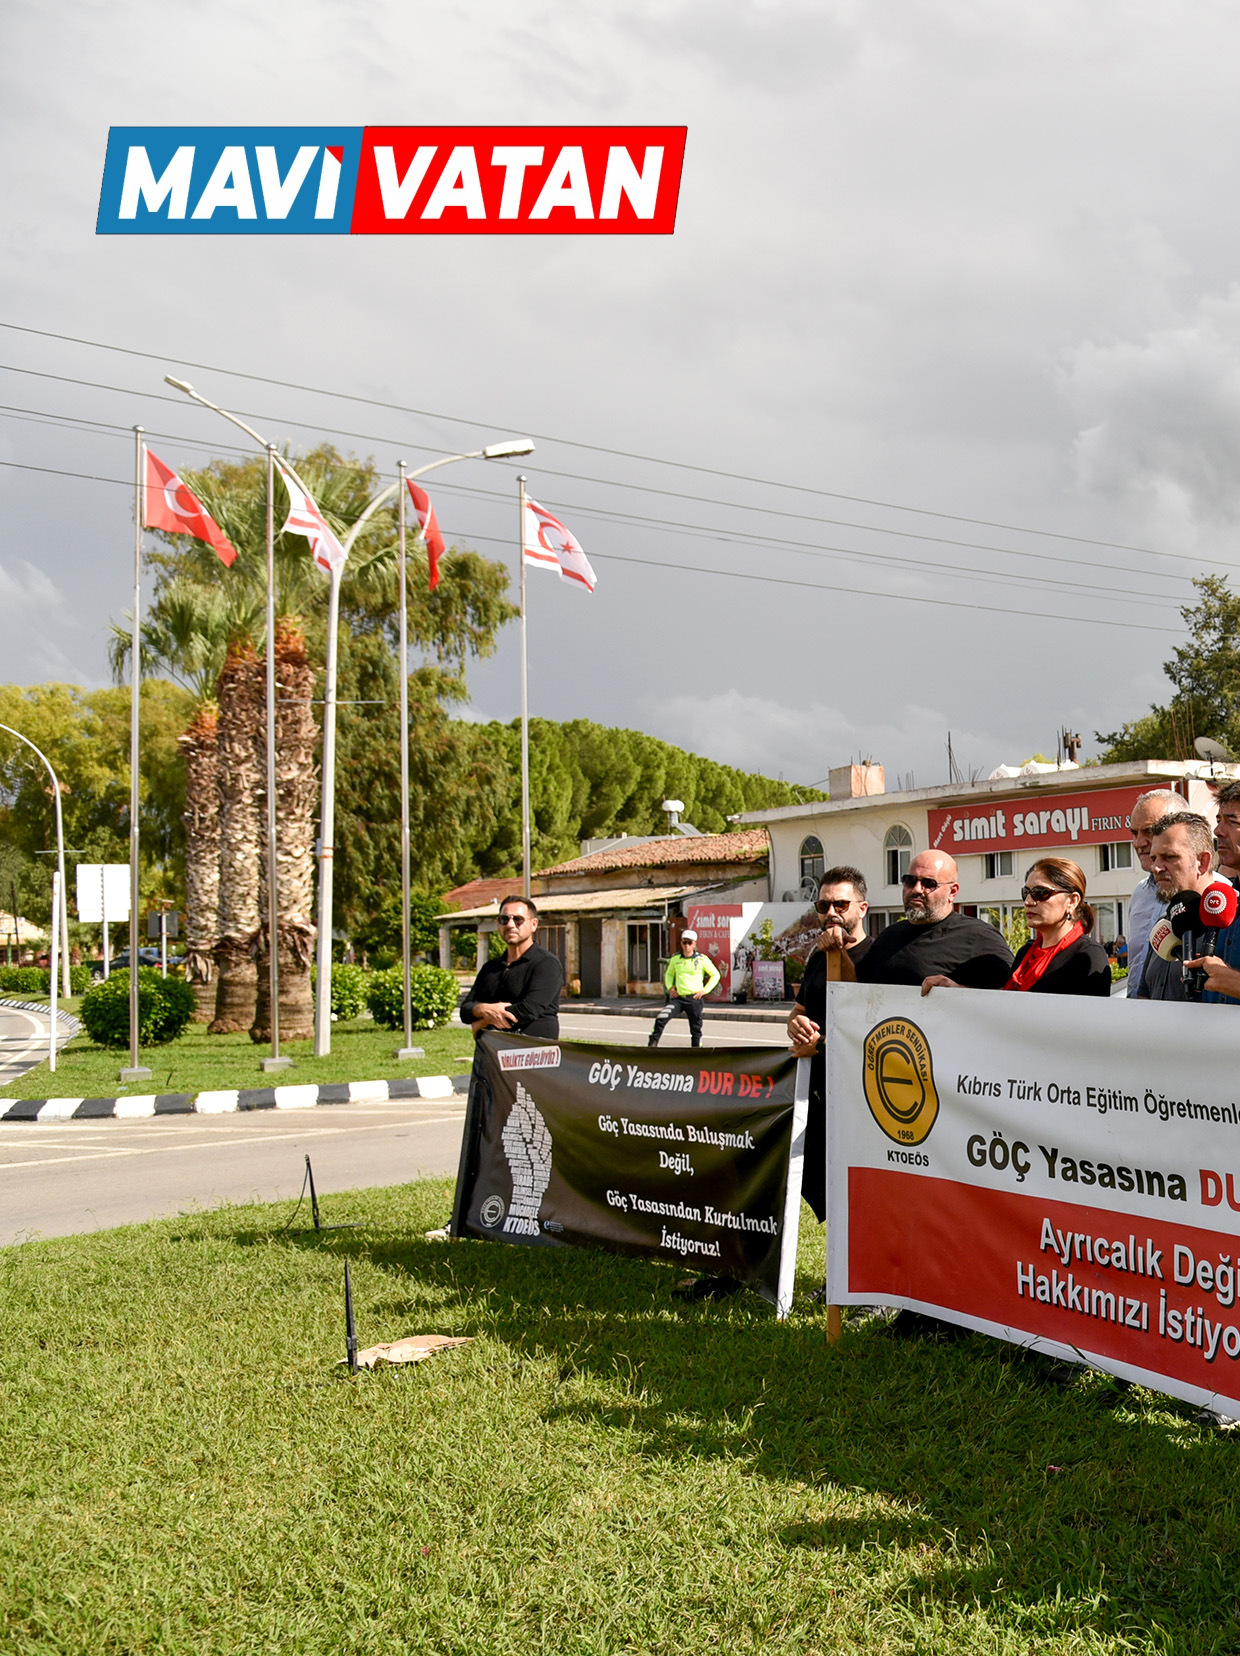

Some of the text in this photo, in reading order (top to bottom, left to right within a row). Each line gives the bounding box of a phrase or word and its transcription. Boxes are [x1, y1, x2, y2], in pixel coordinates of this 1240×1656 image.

[953, 808, 1006, 842] simit
[1091, 815, 1122, 831] FIRIN
[868, 1024, 929, 1082] ÖĞRETMENLER SENDİKASI
[588, 1059, 622, 1091] GÖÇ
[626, 1065, 694, 1093] Yasasına
[697, 1070, 735, 1096] DUR
[737, 1073, 764, 1098] DE
[957, 1074, 1001, 1098] Kıbrıs
[1007, 1078, 1041, 1102] Türk
[1047, 1083, 1080, 1106] Orta
[1086, 1087, 1138, 1114] Eğitim
[598, 1115, 755, 1150] Göç Yasasında Buluşmak
[897, 1129, 915, 1141] 1968
[659, 1151, 695, 1176] Değil,
[887, 1150, 929, 1167] KTOEÖS
[966, 1131, 1031, 1182] GÖÇ
[1037, 1145, 1188, 1201] Yasasına
[606, 1190, 778, 1235] Göç Yasasından Kurtulmak
[660, 1225, 721, 1257] İstiyoruz!
[1040, 1217, 1164, 1279] Ayrıcalık
[1016, 1261, 1149, 1331] Hakkımızı
